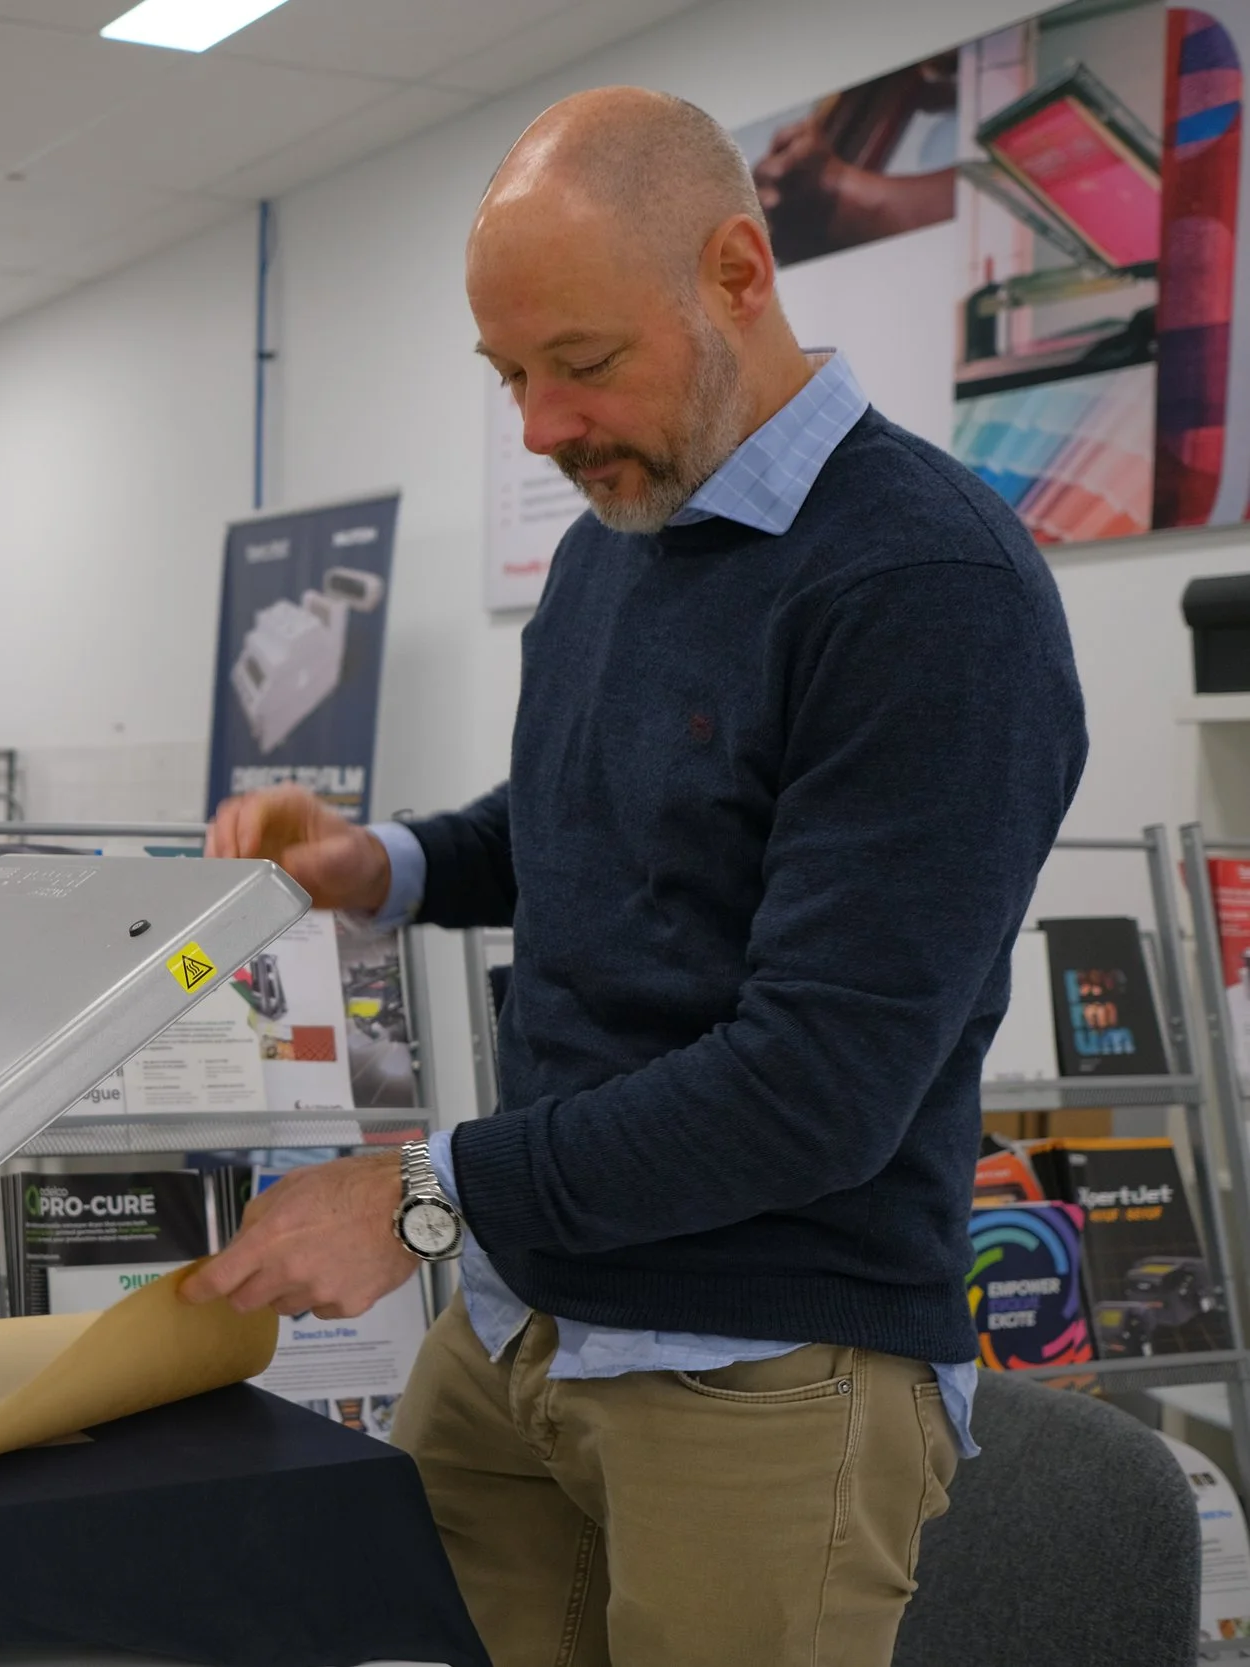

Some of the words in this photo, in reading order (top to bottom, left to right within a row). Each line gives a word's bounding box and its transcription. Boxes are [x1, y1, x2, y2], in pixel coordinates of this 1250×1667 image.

[39, 1194, 157, 1217] PRO-CURE
[988, 1277, 1061, 1298] EMPOWER
[292, 1330, 322, 1340] Direct
[336, 1328, 358, 1337] Film
